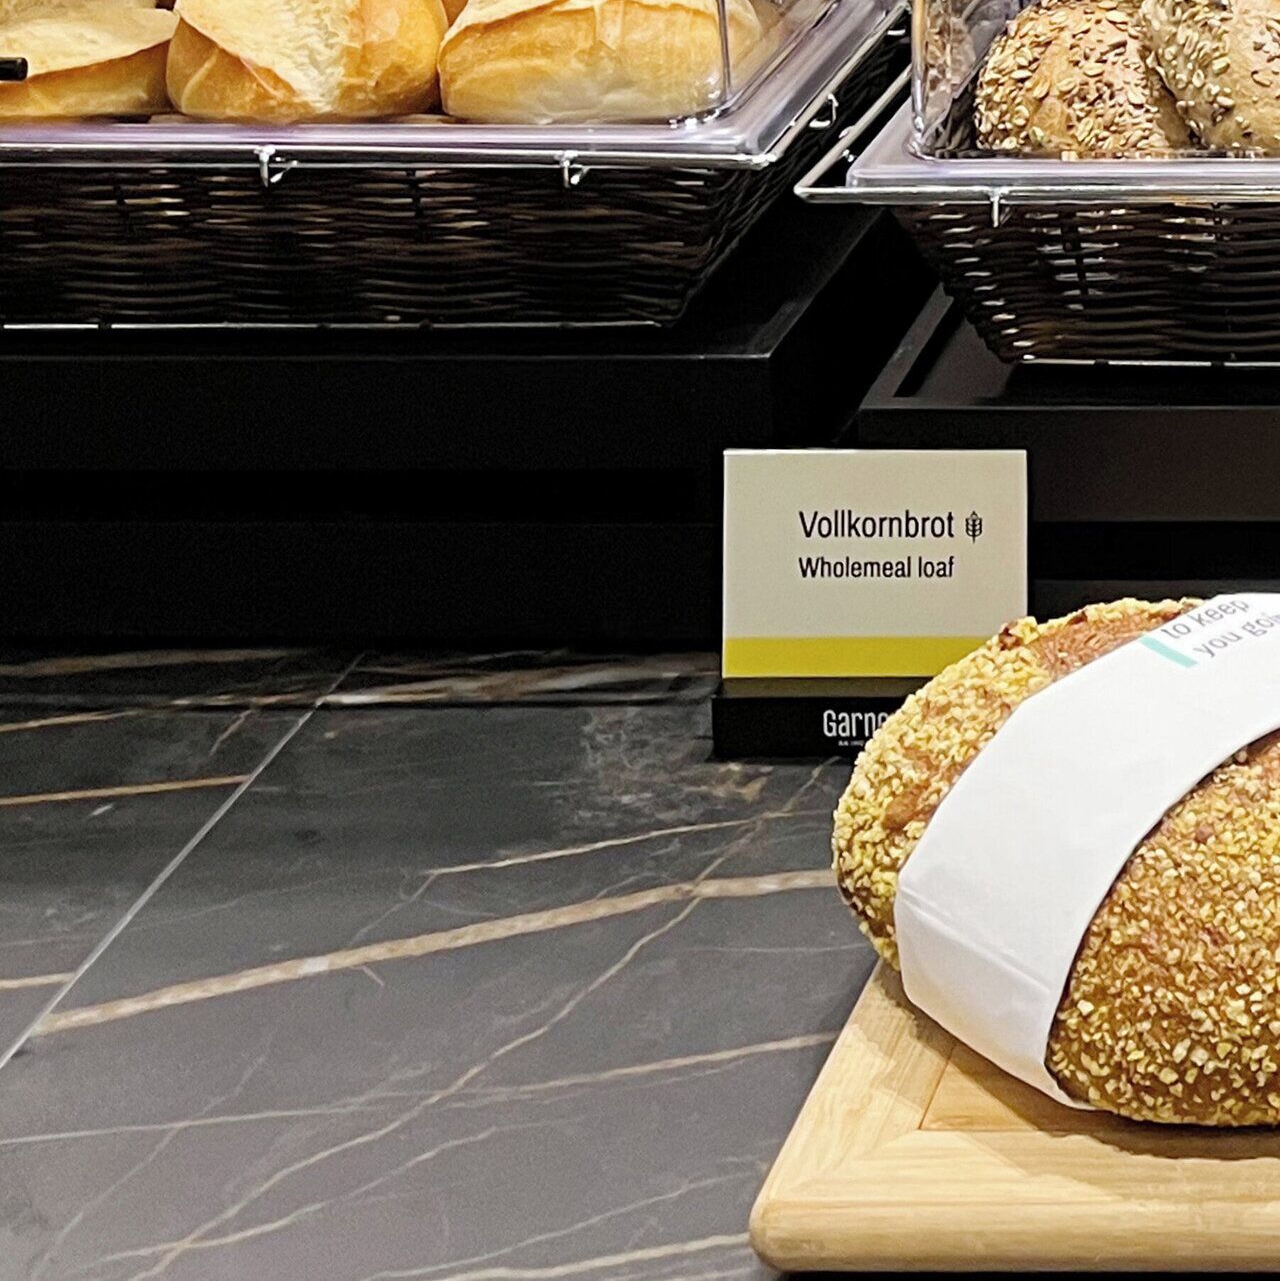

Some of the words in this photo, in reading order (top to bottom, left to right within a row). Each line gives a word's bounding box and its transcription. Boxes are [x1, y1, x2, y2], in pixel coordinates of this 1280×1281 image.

[798, 509, 955, 539] Vollkornbrot
[798, 555, 912, 579] Wholemeal
[917, 555, 955, 579] loaf
[1190, 600, 1250, 627] keep
[1193, 631, 1243, 658] you
